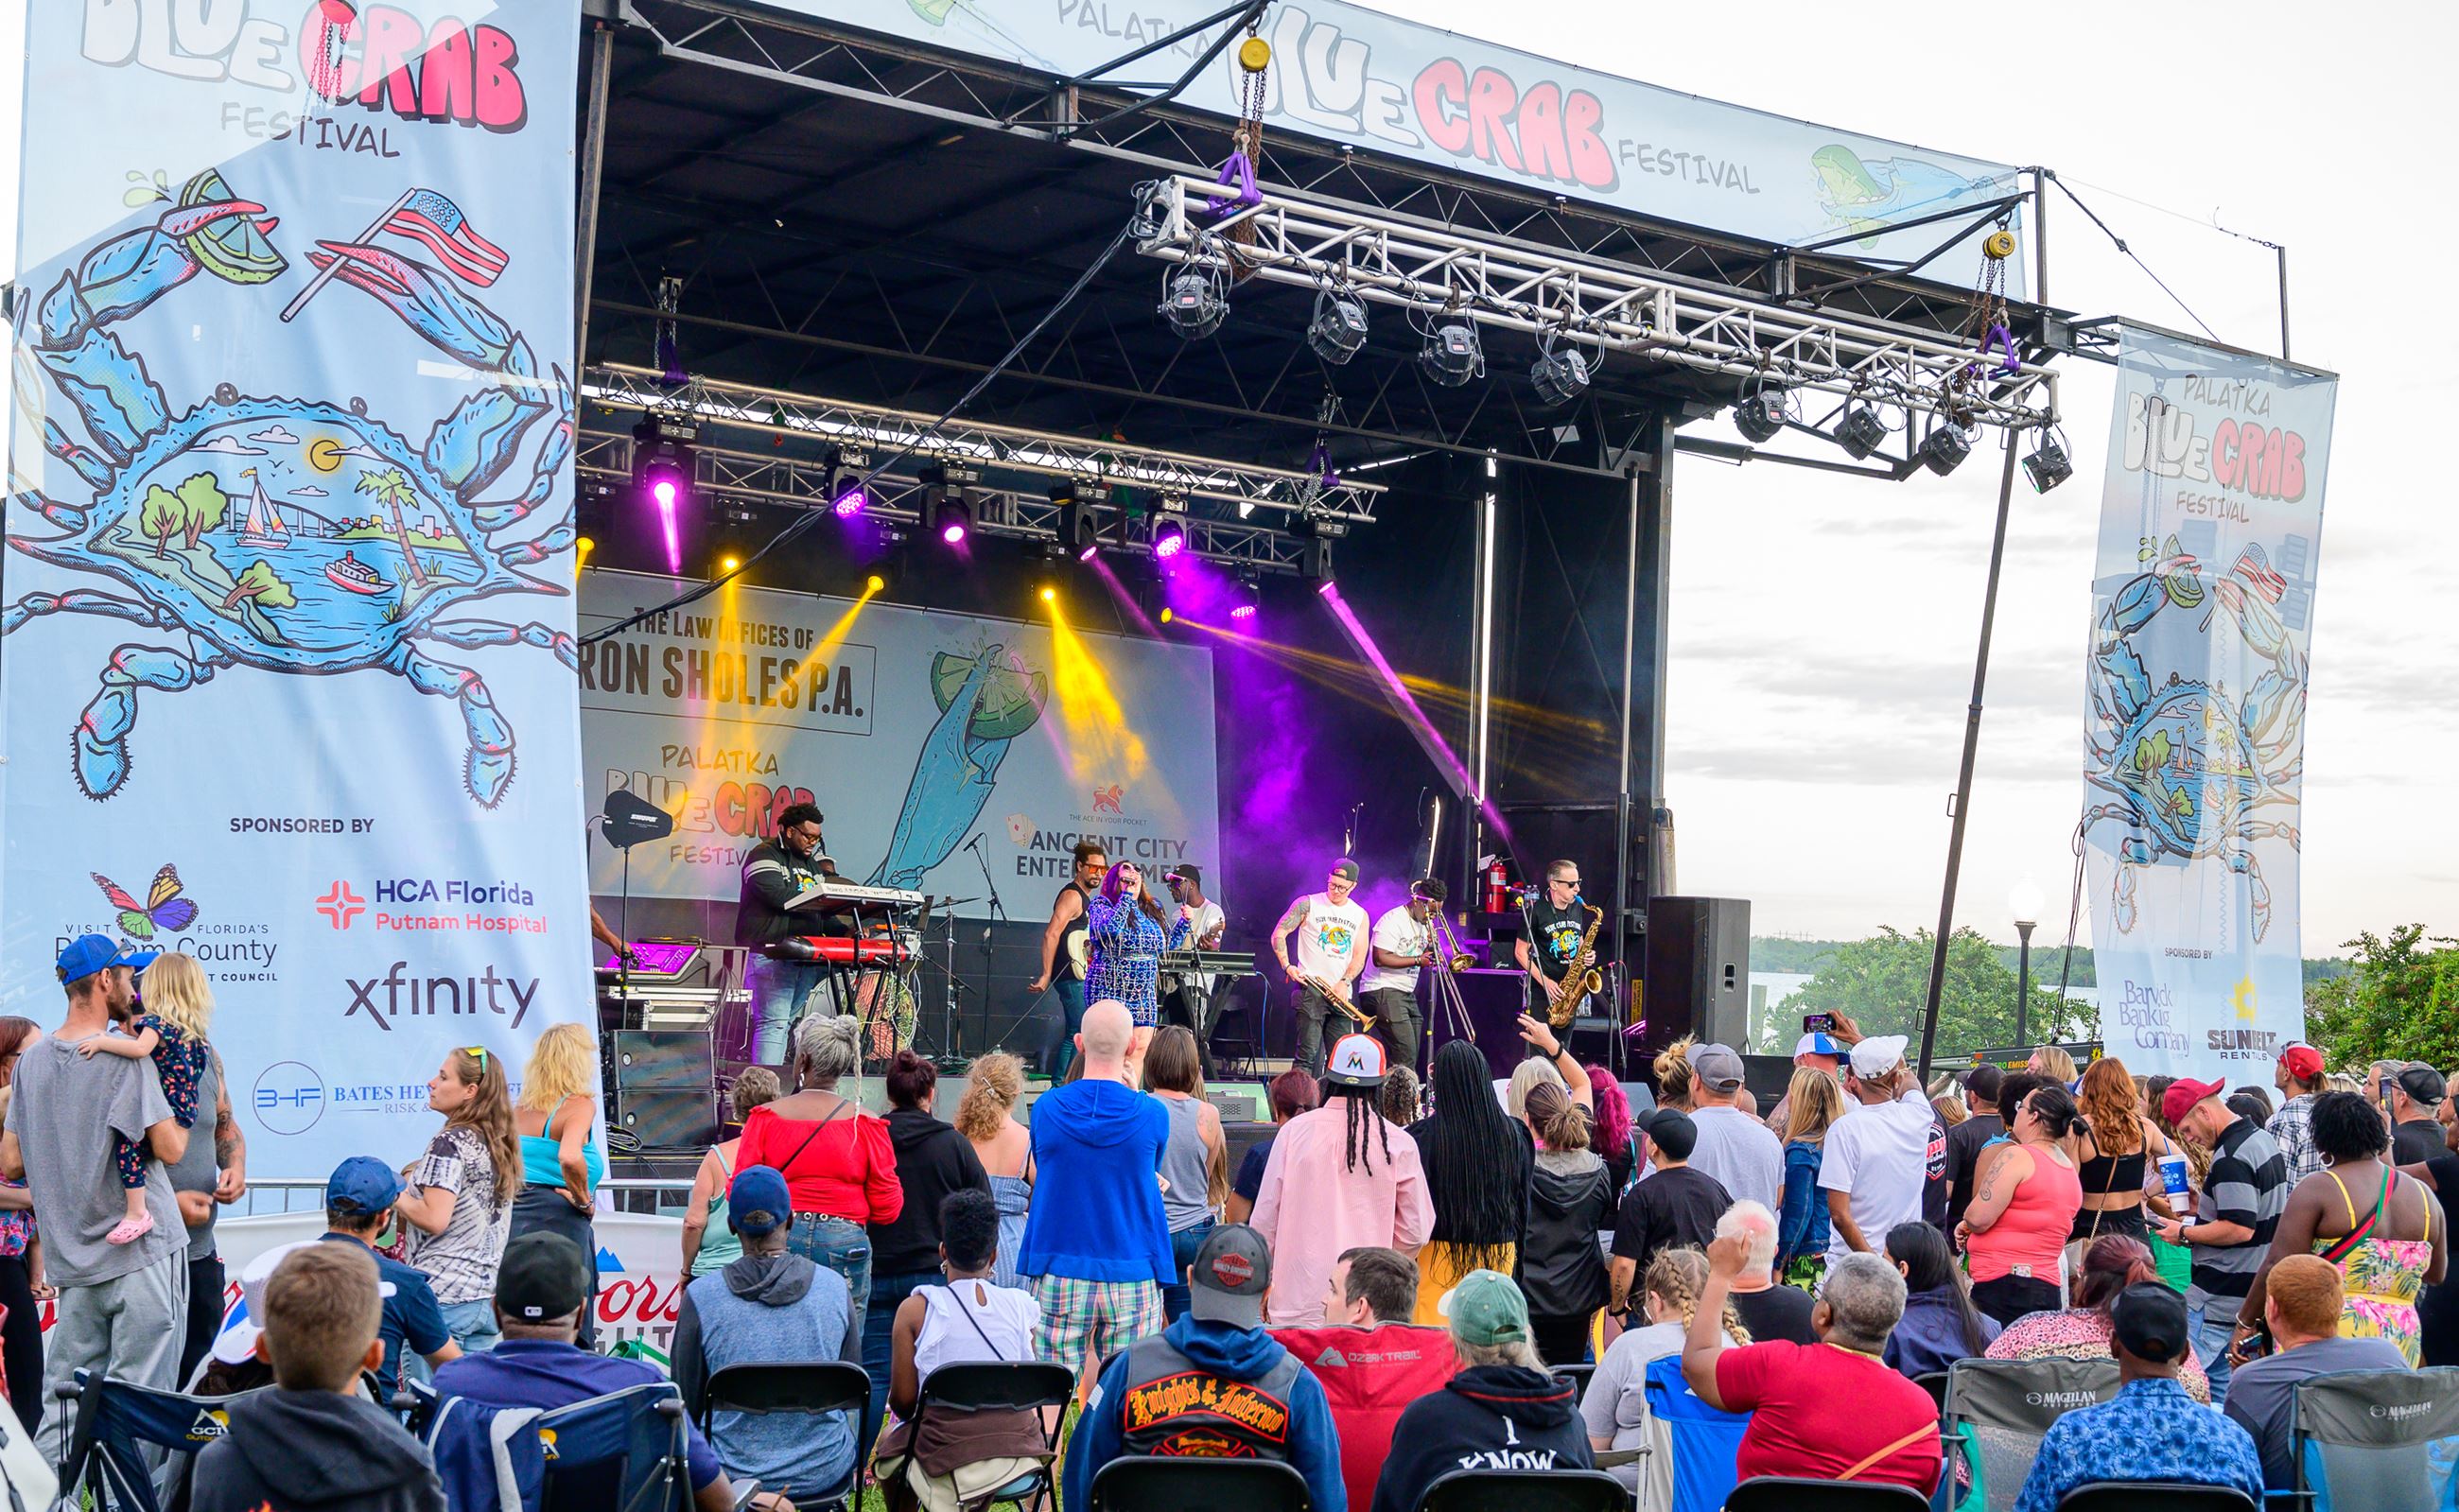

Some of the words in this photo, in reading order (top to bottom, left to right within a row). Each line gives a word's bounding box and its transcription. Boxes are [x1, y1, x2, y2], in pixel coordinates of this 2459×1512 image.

[1057, 0, 1216, 64] PALATKA
[297, 2, 528, 134] CRAB
[220, 101, 400, 159] FESTIVAL
[1413, 56, 1620, 194] CRAB
[1619, 139, 1761, 196] FESTIVAL
[2184, 374, 2270, 419] PALATKA
[2123, 391, 2210, 484] BLUE
[2211, 417, 2306, 504] CRAB
[2176, 490, 2250, 524] FESTIVAL
[634, 606, 667, 635] THE
[673, 611, 713, 639] LAW
[718, 617, 789, 649] OFFICES
[794, 627, 813, 651] OF
[662, 646, 800, 710] SHOLES
[808, 662, 864, 718] P.A.
[661, 744, 779, 776] PALATKA
[230, 817, 344, 834] SPONSORED
[351, 818, 375, 833] BY
[1096, 815, 1103, 824] IN
[1104, 816, 1122, 825] YOUR
[1123, 817, 1147, 826] POCKET
[670, 844, 748, 867] FESTIV
[1135, 838, 1188, 860] CITY
[375, 878, 440, 903] HCA
[445, 879, 534, 907] Florida
[65, 924, 112, 934] VISIT
[197, 924, 270, 934] FLORIDA'S
[375, 912, 460, 931] Putnam
[465, 913, 548, 935] Hospital
[177, 937, 278, 968] County
[2203, 949, 2213, 960] BY
[220, 973, 278, 982] COUNCIL
[343, 961, 540, 1032] xfinity
[2007, 1060, 2029, 1069] EMISS
[2220, 1051, 2268, 1061] RENS
[334, 1086, 393, 1102] BATES
[384, 1103, 416, 1114] RISK
[594, 1275, 680, 1323] ors
[1348, 1352, 1385, 1363] OZARK
[1386, 1349, 1422, 1362] TRAIL
[1130, 1377, 1201, 1426] Knights
[1211, 1383, 1285, 1433] Inferno
[2043, 1391, 2096, 1403] MAGELLAN
